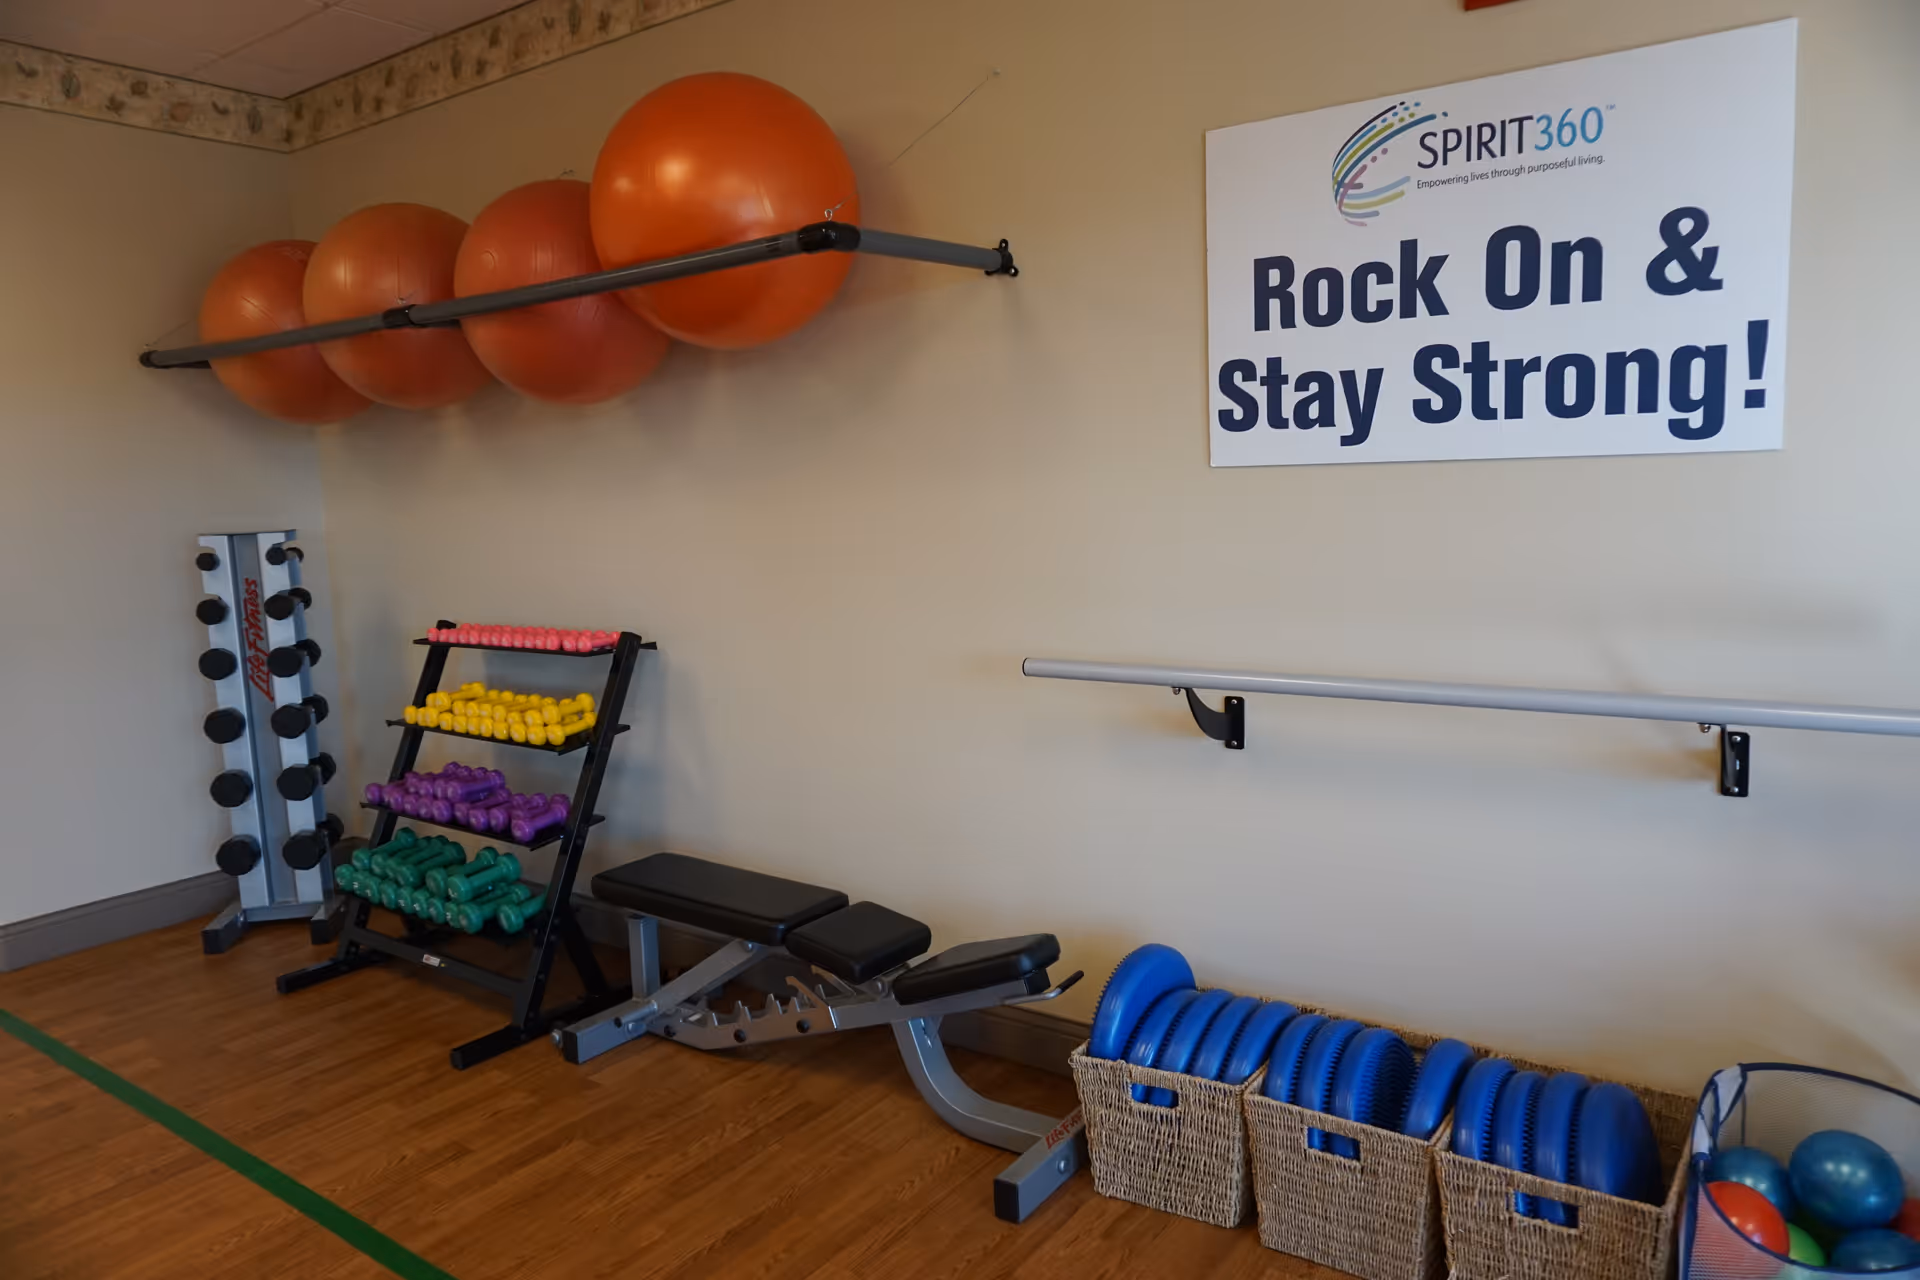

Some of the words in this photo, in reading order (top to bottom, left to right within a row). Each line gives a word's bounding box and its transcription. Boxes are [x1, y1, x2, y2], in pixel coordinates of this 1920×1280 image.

[1417, 106, 1604, 169] SPIRIT360
[1417, 174, 1469, 189] Empowering
[1470, 169, 1490, 182] lives
[1491, 164, 1526, 179] through
[1528, 157, 1576, 173] purposeful
[1578, 154, 1605, 166] living.
[1254, 239, 1449, 332] Rock
[1485, 225, 1603, 310] On
[1646, 206, 1723, 296] &
[1218, 357, 1384, 447] Stay
[1413, 319, 1769, 440] Strong!
